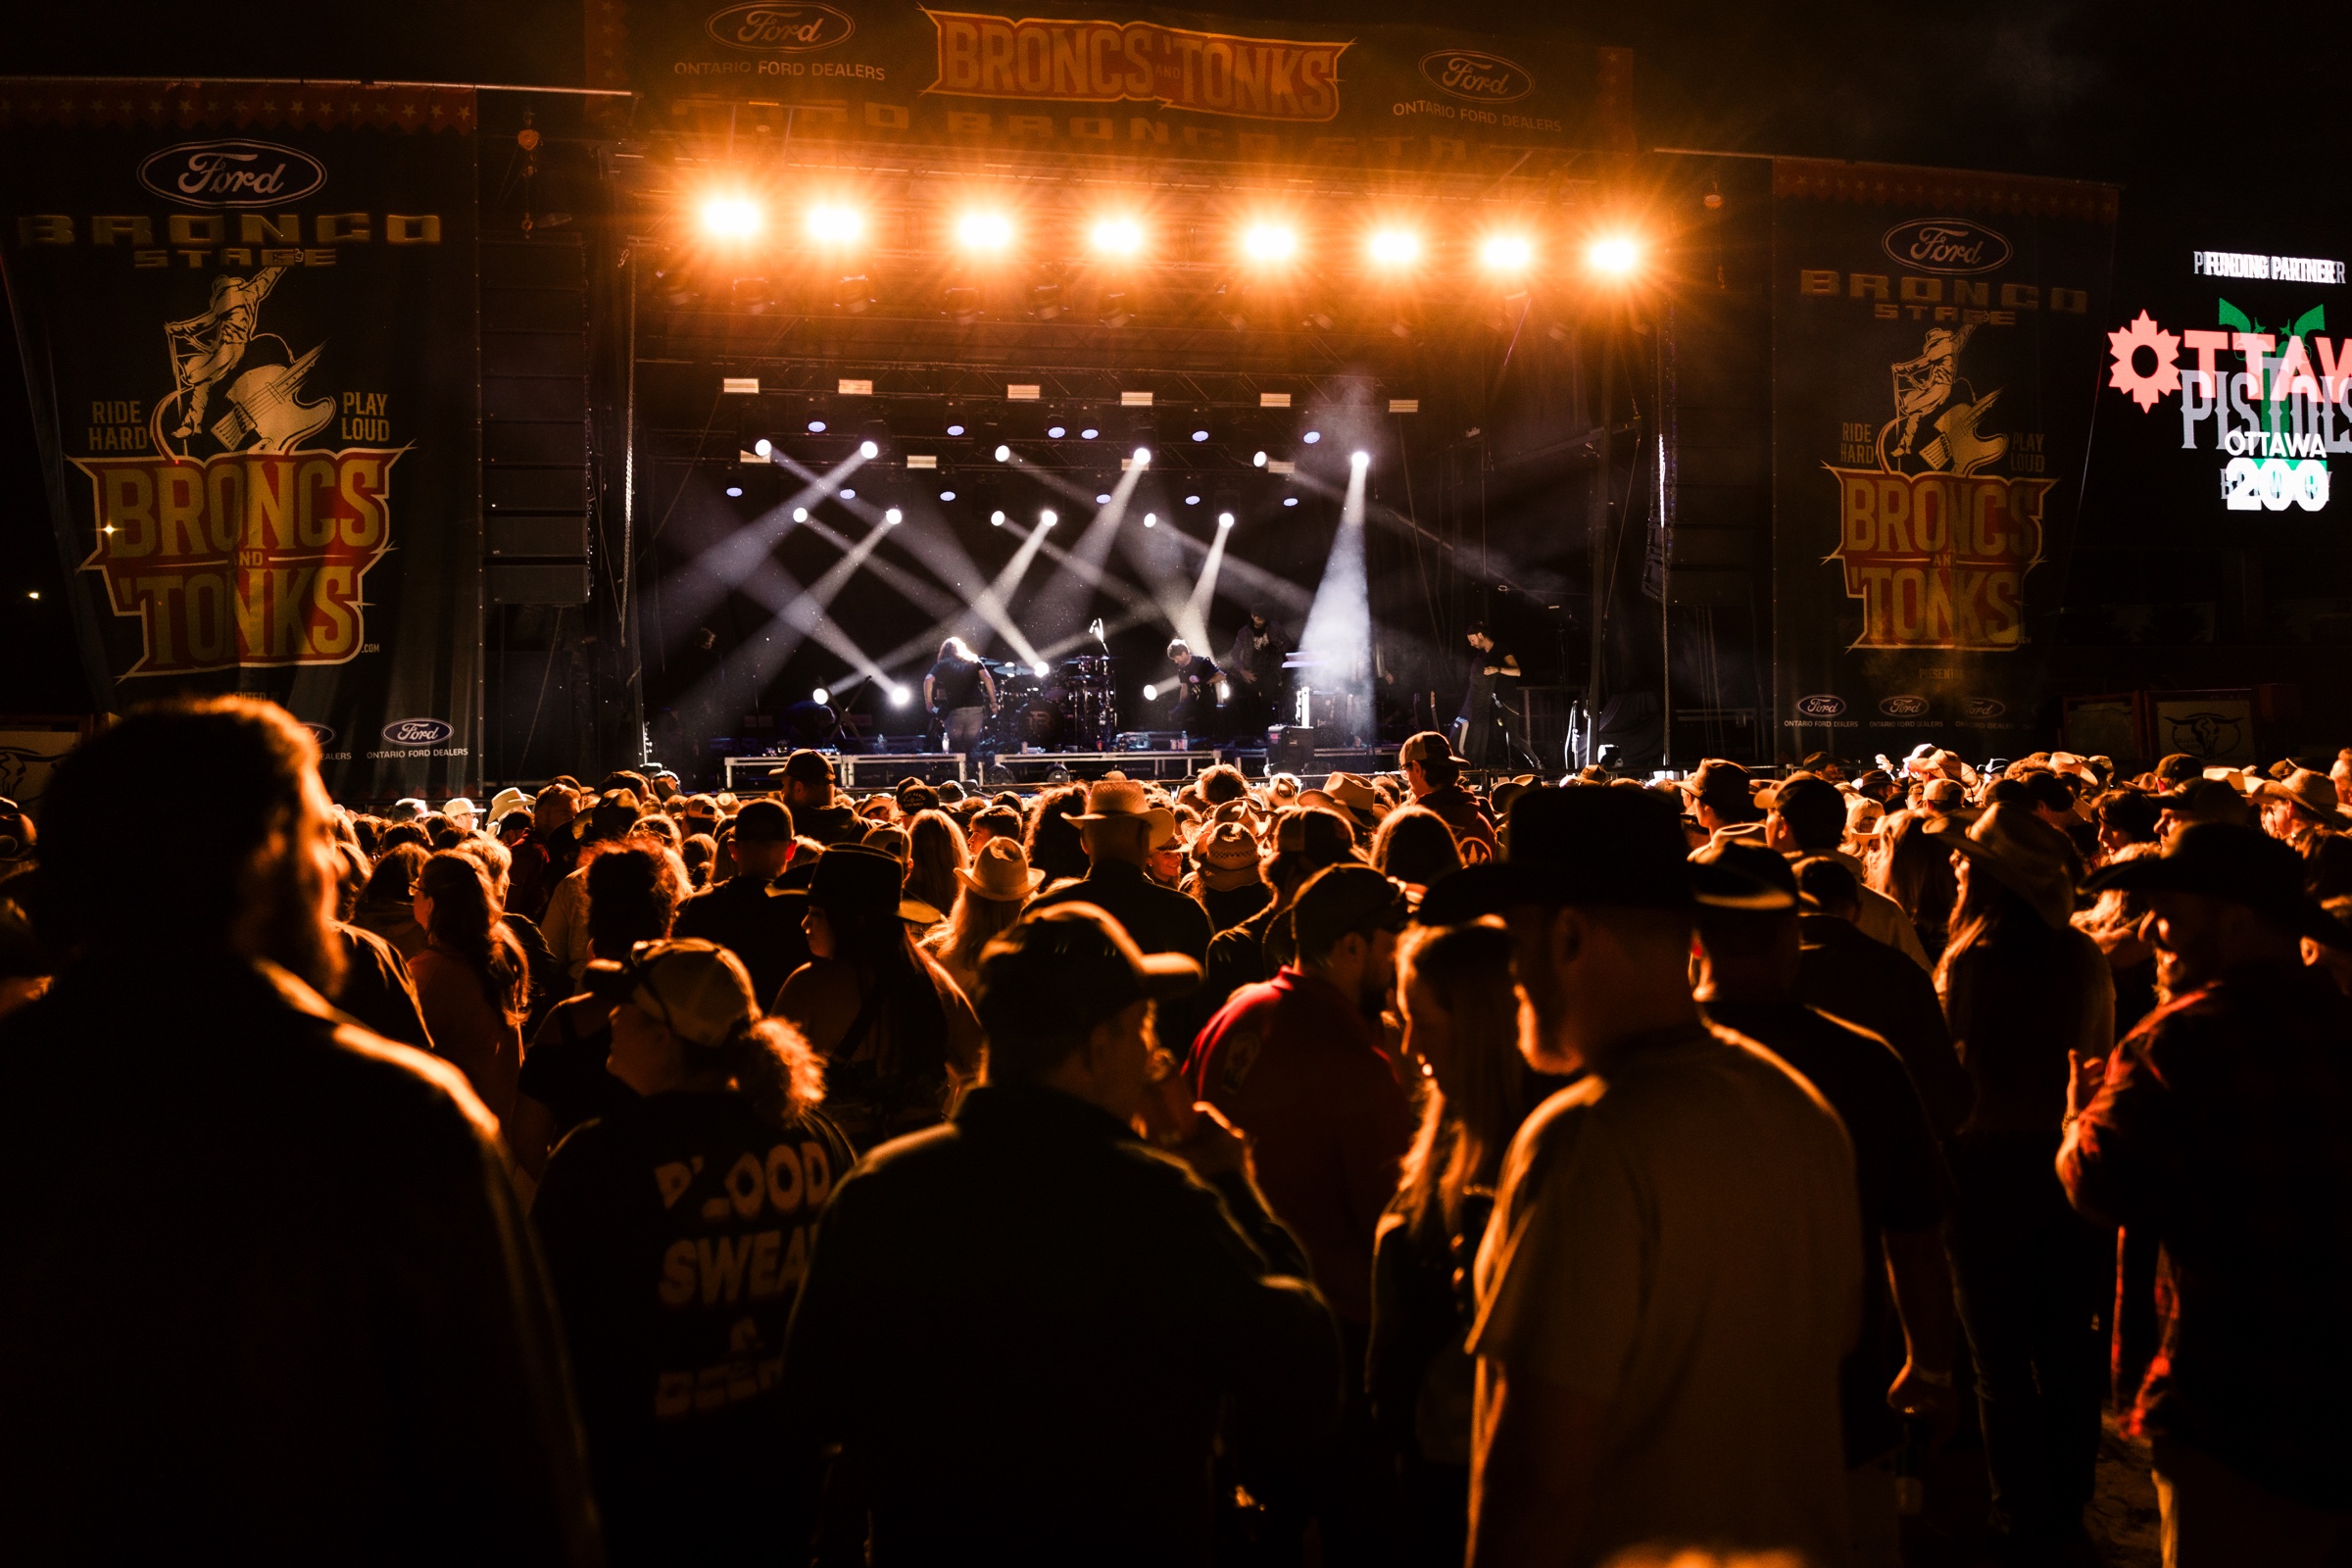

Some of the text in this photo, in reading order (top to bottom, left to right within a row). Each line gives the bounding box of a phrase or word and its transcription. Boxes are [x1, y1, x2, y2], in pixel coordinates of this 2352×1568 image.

[737, 9, 824, 42] Ford
[944, 20, 1154, 95] BRONCS
[673, 61, 885, 81] ONTARIO FORD DEALERS
[1442, 57, 1509, 94] Ford
[1393, 100, 1562, 132] ONTARIO FORD DEALERS
[177, 152, 287, 194] Ford
[18, 213, 441, 244] BRONCO
[134, 248, 337, 268] STAGE
[1910, 226, 1984, 265] Ford
[2271, 256, 2337, 284] PARTNER
[1800, 270, 2089, 315] BRONCO
[1874, 303, 2017, 325] STAGE
[91, 401, 141, 424] RIDE
[342, 391, 389, 416] PLAY
[88, 427, 148, 451] HARD
[341, 417, 391, 442] LOUD
[1842, 422, 1872, 443] RIDE
[2012, 431, 2045, 452] PLAY
[1839, 444, 1875, 465] HARD
[2224, 431, 2328, 458] OTTAWA
[2010, 453, 2046, 472] LOUD
[2226, 457, 2329, 512] 200
[105, 458, 381, 560] BRONCS
[1844, 478, 2036, 558] BRONCS
[1807, 698, 1838, 714] Ford
[1889, 699, 1920, 713] Ford
[397, 722, 440, 741] Ford
[320, 752, 352, 761] EALERS
[366, 750, 406, 760] ONTARIO
[433, 747, 469, 758] DEALERS
[657, 1223, 819, 1308] SWEA
